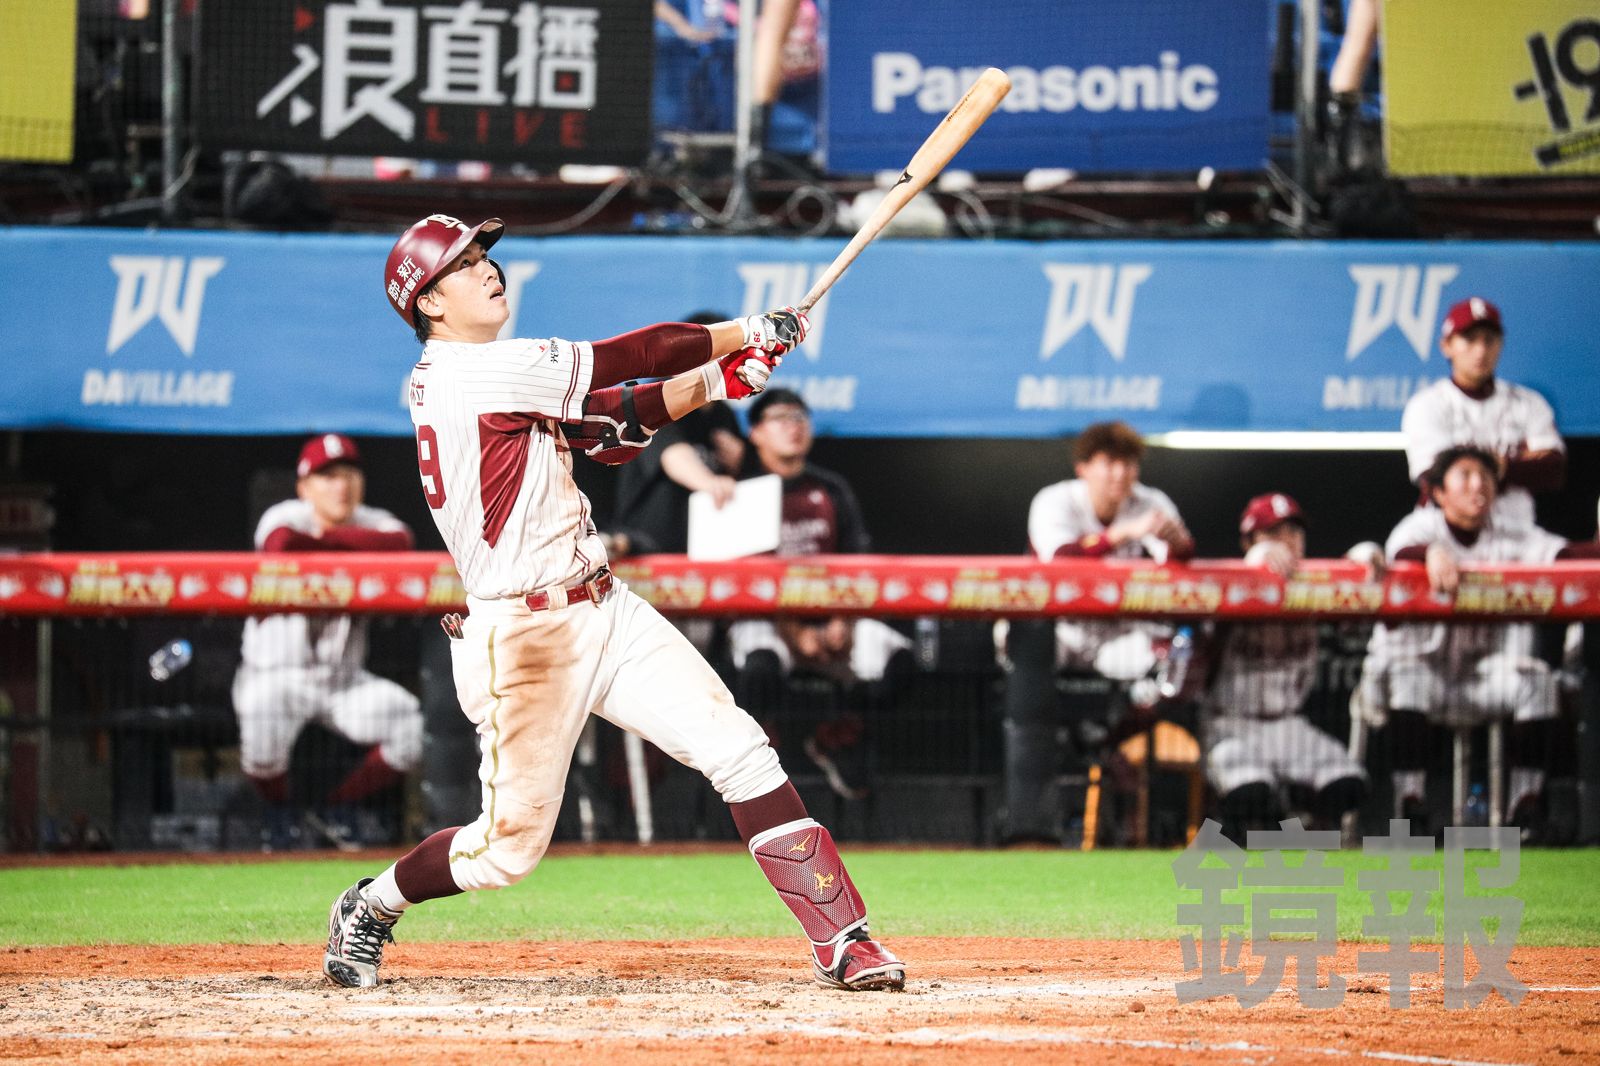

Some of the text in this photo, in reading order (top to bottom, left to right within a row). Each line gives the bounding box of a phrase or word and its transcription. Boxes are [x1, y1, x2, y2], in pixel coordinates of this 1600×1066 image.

[256, 0, 599, 141] 浪直播
[425, 106, 587, 148] LIVE
